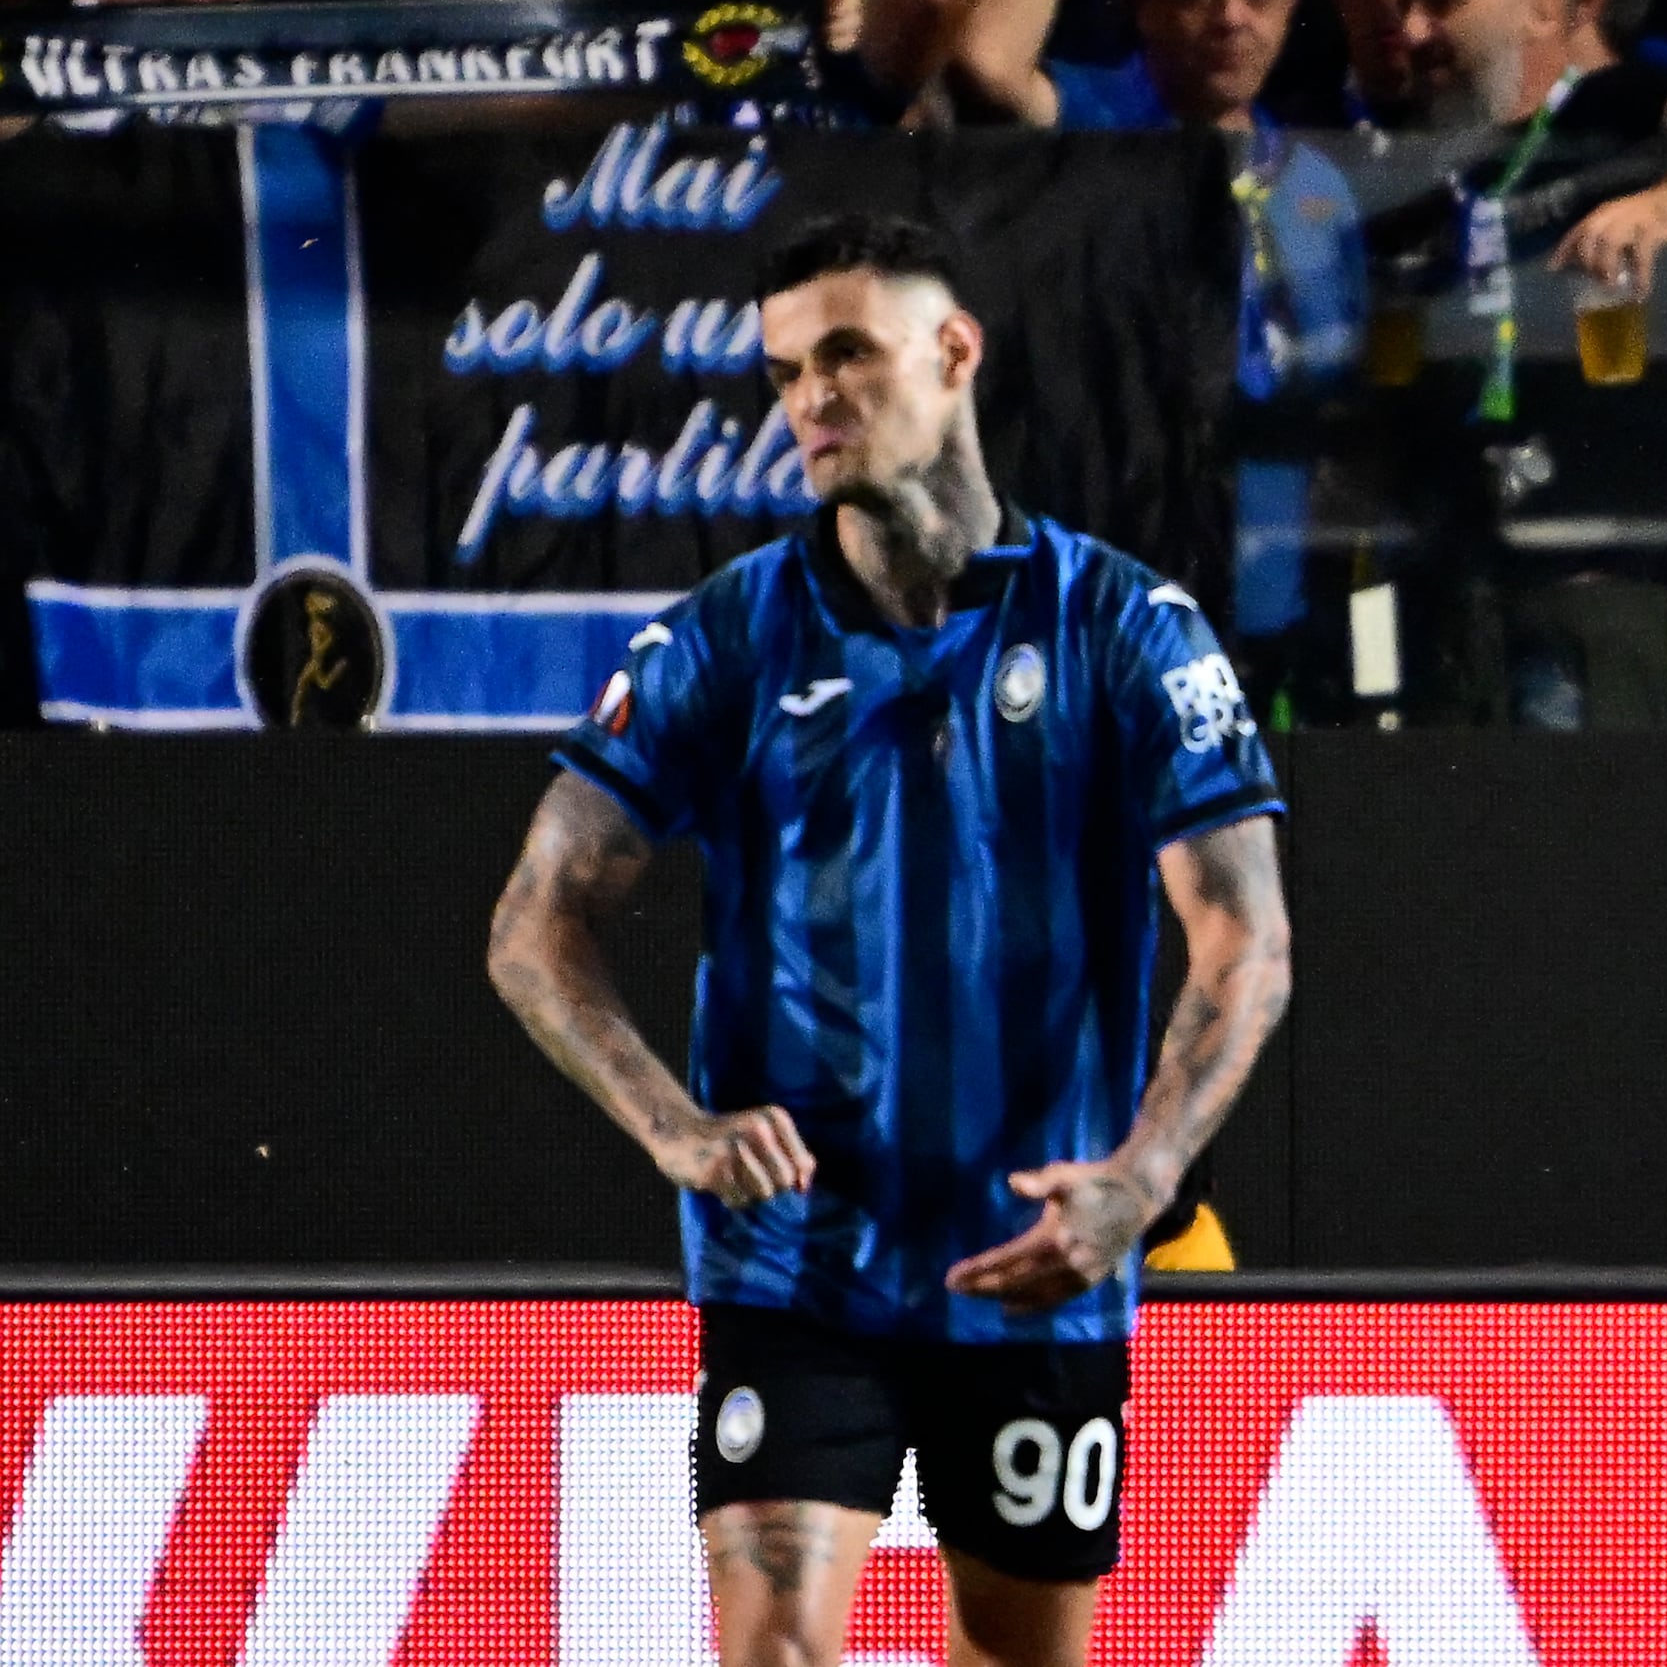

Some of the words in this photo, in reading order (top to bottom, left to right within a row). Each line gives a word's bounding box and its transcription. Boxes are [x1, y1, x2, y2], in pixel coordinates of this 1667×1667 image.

[20, 34, 267, 99] ULTRAS
[540, 111, 785, 234] Mai
[442, 251, 660, 376] solo
[992, 1416, 1118, 1532] 90
